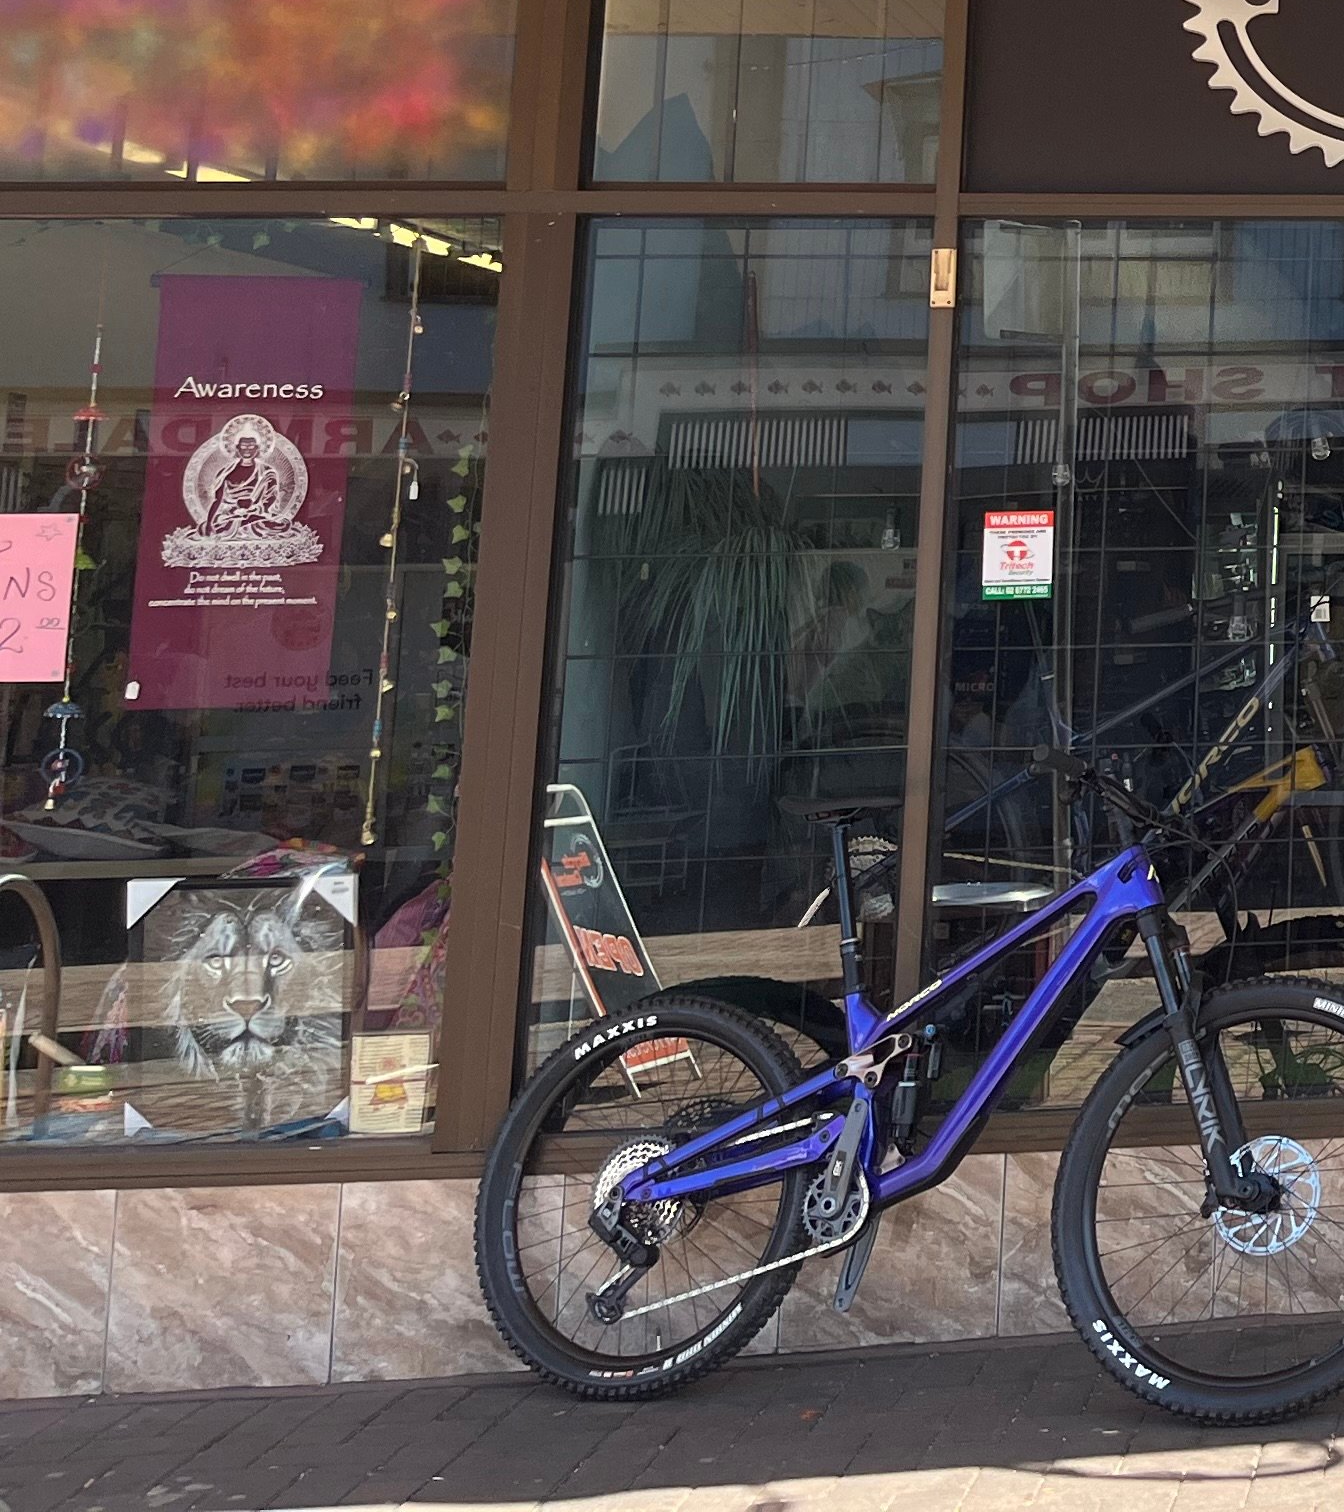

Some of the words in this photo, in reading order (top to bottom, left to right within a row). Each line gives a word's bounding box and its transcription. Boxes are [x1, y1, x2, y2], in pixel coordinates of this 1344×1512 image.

[173, 376, 325, 400] Awareness
[990, 514, 1049, 525] WARNING
[574, 1015, 658, 1061] MAXXIS
[1092, 1319, 1171, 1390] MAXXIS
